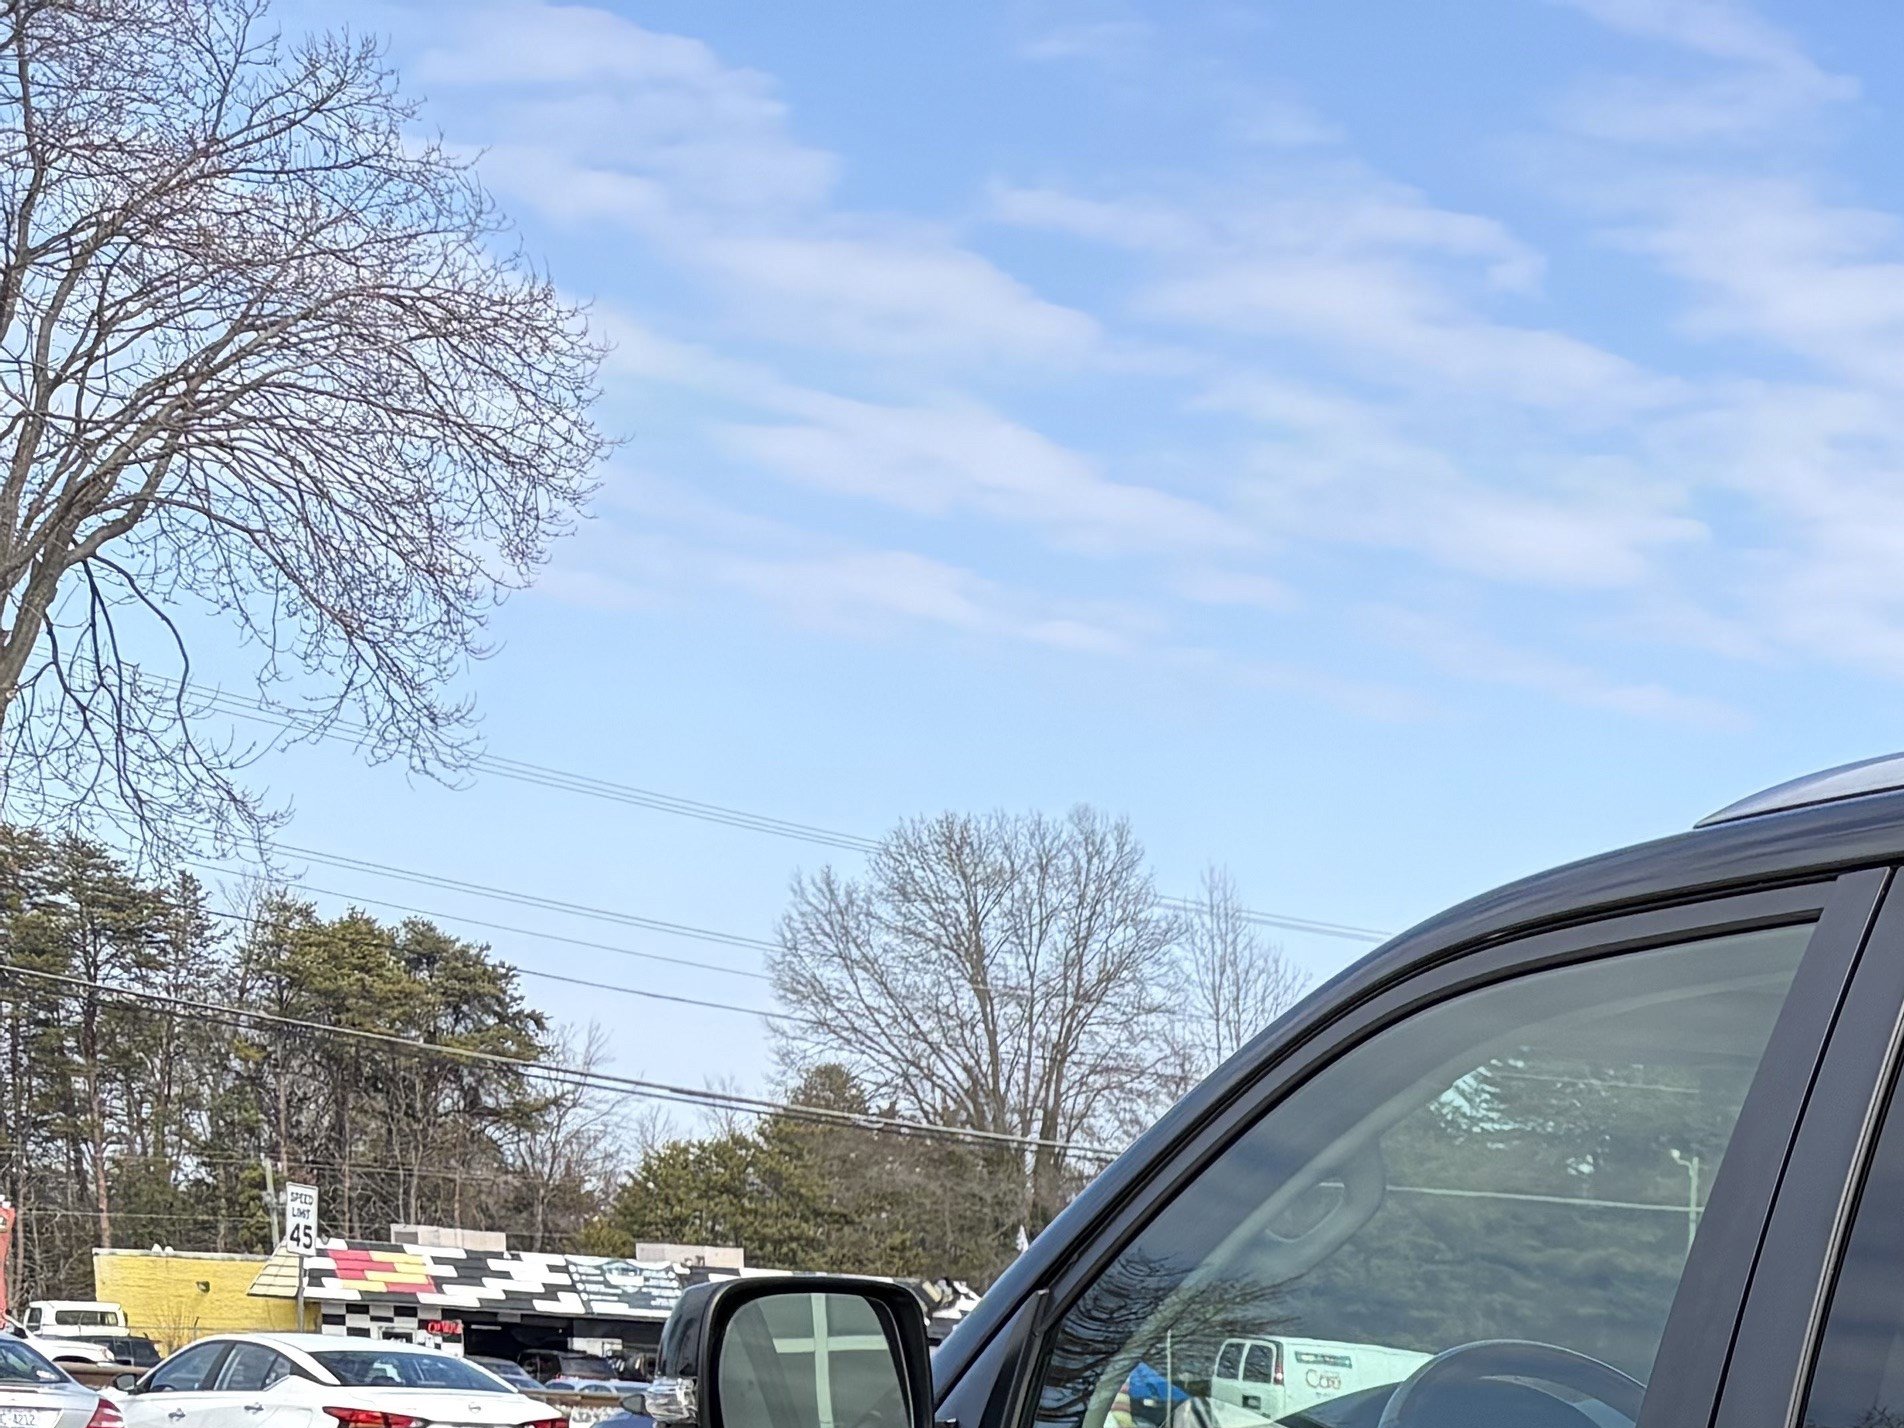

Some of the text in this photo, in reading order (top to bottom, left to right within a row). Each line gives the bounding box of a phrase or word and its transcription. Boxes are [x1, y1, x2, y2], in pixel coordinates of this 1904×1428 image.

[290, 1191, 314, 1206] SPEED
[291, 1206, 311, 1220] LIMIT
[290, 1223, 313, 1250] 45
